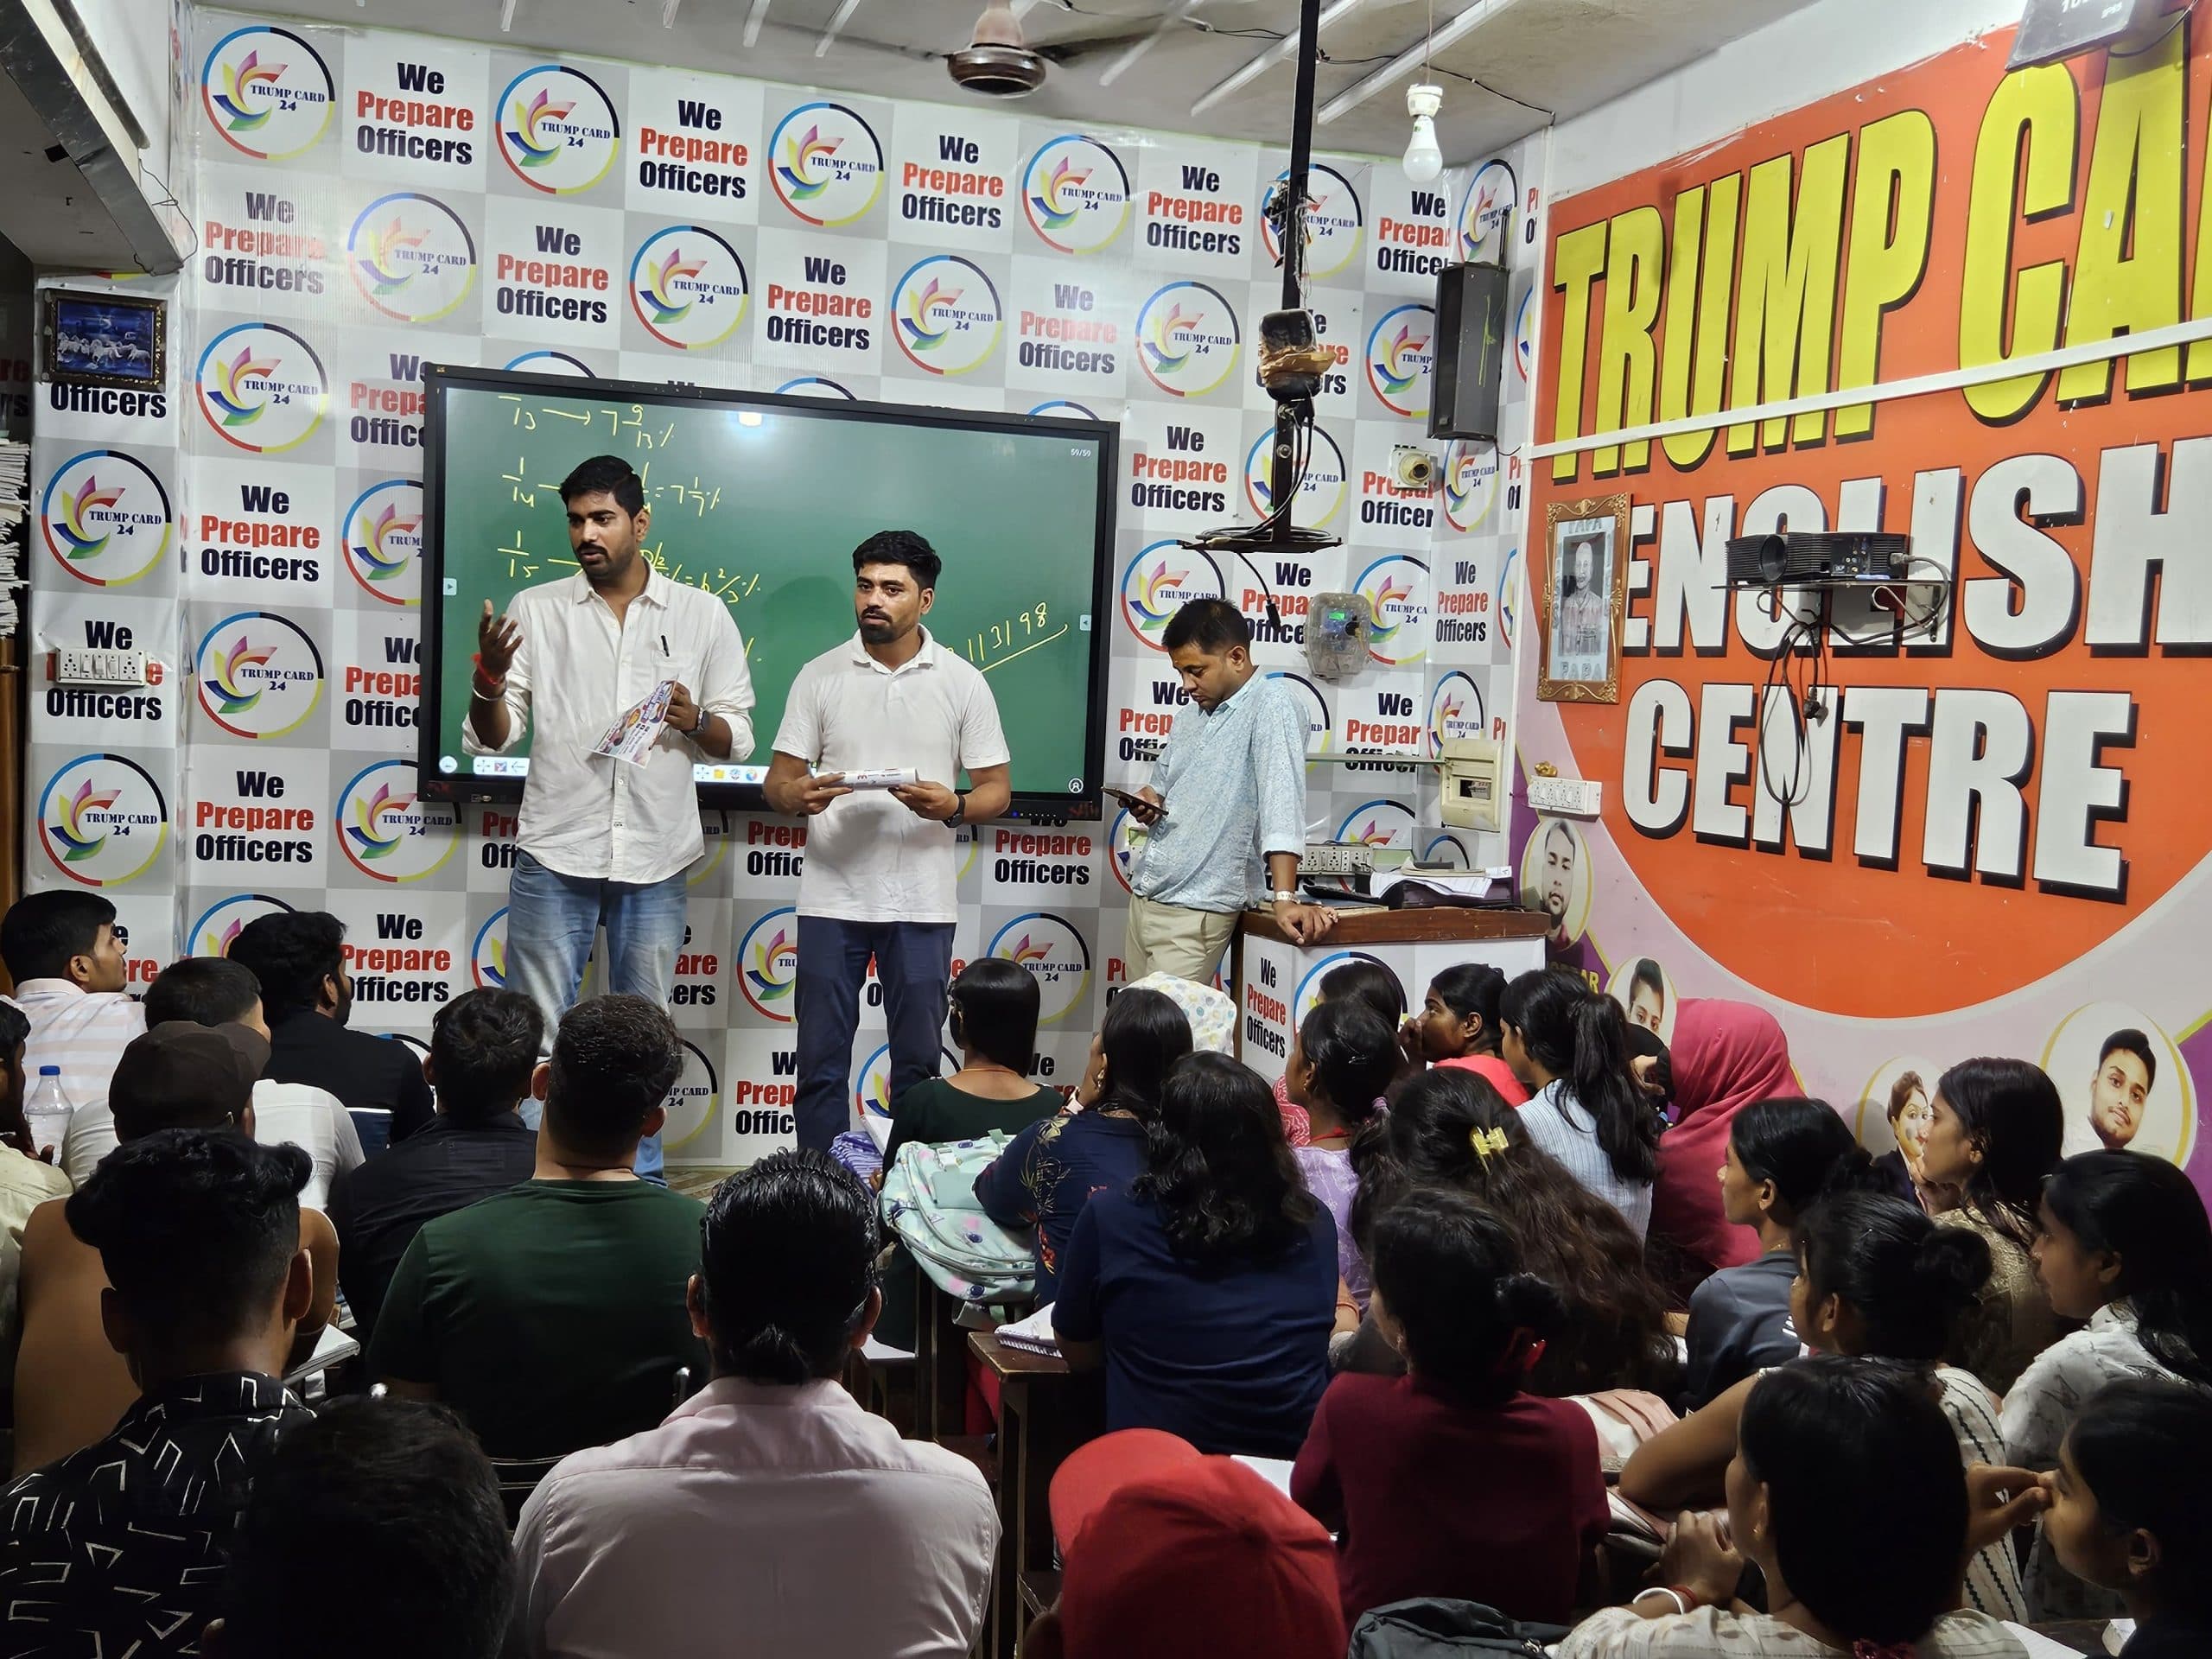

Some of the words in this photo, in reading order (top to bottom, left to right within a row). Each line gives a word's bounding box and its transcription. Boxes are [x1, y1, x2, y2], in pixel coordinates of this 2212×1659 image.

[397, 63, 444, 94] We
[251, 85, 292, 99] TRUMP
[296, 90, 325, 103] CARD
[279, 100, 297, 111] 24
[358, 91, 474, 131] Prepare
[678, 100, 721, 130] We
[541, 122, 580, 136] TRUMP
[582, 127, 611, 139] CARD
[568, 137, 584, 148] 24
[357, 125, 473, 165] Officers
[640, 128, 747, 167] Prepare
[939, 135, 979, 164] We
[811, 157, 849, 169] TRUMP
[851, 161, 875, 173] CARD
[836, 170, 851, 181] 24
[639, 162, 747, 199] Officers
[903, 162, 1003, 197] Prepare
[1182, 165, 1219, 192] We
[1062, 188, 1095, 199] TRUMP
[1096, 191, 1122, 201] CARD
[1084, 200, 1098, 210] 24
[1411, 191, 1446, 217] We
[245, 192, 295, 224] We
[902, 194, 1001, 228] Officers
[1147, 191, 1243, 225] Prepare
[1306, 216, 1329, 226] RUMP
[1332, 218, 1355, 227] CARD
[1319, 227, 1332, 236] 24
[1379, 217, 1450, 247] Prepa
[536, 226, 581, 256] We
[1147, 222, 1240, 256] Officers
[1553, 110, 1936, 480] TRUMP
[1959, 13, 2212, 423] CA
[395, 249, 435, 263] TRUMP
[437, 254, 467, 266] CARD
[422, 264, 439, 275] 24
[1377, 247, 1447, 276] Office
[205, 256, 324, 295] Officers
[497, 254, 608, 291] Prepare
[804, 257, 846, 286] We
[673, 280, 710, 293] TRUMP
[712, 283, 740, 296] CARD
[698, 294, 714, 304] 24
[1054, 283, 1094, 311] We
[496, 288, 607, 323] Officers
[767, 284, 871, 319] Prepare
[932, 308, 966, 319] TRUMP
[968, 311, 994, 321] CARD
[766, 316, 870, 350] Officers
[955, 321, 969, 330] 24
[1020, 310, 1116, 343] Prepare
[1173, 332, 1205, 344] TRUMP
[1208, 335, 1232, 345] CARD
[1019, 341, 1115, 373] Officers
[1195, 344, 1209, 353] 24
[390, 353, 425, 381] W
[51, 384, 166, 418] Officers
[245, 380, 285, 394] TRUMP
[289, 384, 319, 397] CARD
[272, 393, 290, 405] 24
[351, 383, 425, 416] Prep
[351, 416, 424, 448] Offic
[1167, 427, 1205, 452] We
[1133, 454, 1227, 483] Prepare
[1315, 474, 1338, 483] CARD
[241, 485, 289, 515] We
[1131, 483, 1224, 512] Officers
[1303, 483, 1317, 492] 24
[89, 511, 129, 524] TRUMP
[131, 514, 162, 525] CARD
[1362, 500, 1433, 527] Officer
[118, 524, 134, 536] 24
[201, 515, 320, 550] Prepare
[389, 536, 423, 546] TRUM
[1623, 436, 2212, 655] ENGLISH
[201, 549, 319, 582] Officers
[1276, 563, 1311, 587] We
[1456, 562, 1476, 584] We
[1160, 590, 1192, 600] TRUMP
[1438, 591, 1488, 615] Prepare
[1385, 604, 1414, 613] TRUMP
[85, 620, 132, 650] We
[1436, 619, 1486, 642] Officers
[241, 669, 279, 681] TRUMP
[282, 671, 314, 682] CARD
[269, 681, 286, 691] 24
[47, 688, 162, 721] Officers
[1153, 682, 1189, 705] We
[1378, 693, 1413, 716] We
[346, 699, 420, 727] Offic
[1120, 709, 1173, 735] Prep
[1347, 719, 1421, 746] Prepar
[237, 771, 283, 798] We
[1623, 678, 2136, 902] CENTRE
[86, 814, 124, 824] TRUMP
[128, 814, 157, 825] CARD
[196, 802, 314, 831] Prepare
[383, 815, 421, 824] TRUMP
[423, 816, 452, 826] CARD
[113, 825, 130, 836] 24
[410, 826, 425, 836] 24
[748, 821, 807, 849] Prep
[995, 830, 1091, 856] Prepare
[195, 834, 312, 863] Officers
[747, 851, 804, 876] Offic
[995, 859, 1090, 885] Officers
[377, 914, 423, 939] We
[1261, 957, 1276, 988] We
[1248, 983, 1286, 1026] Prepare
[1247, 1015, 1286, 1058] Officers
[772, 1052, 797, 1075] W
[668, 1097, 684, 1107] 24
[737, 1081, 794, 1107] Prep
[736, 1110, 794, 1135] Offic
